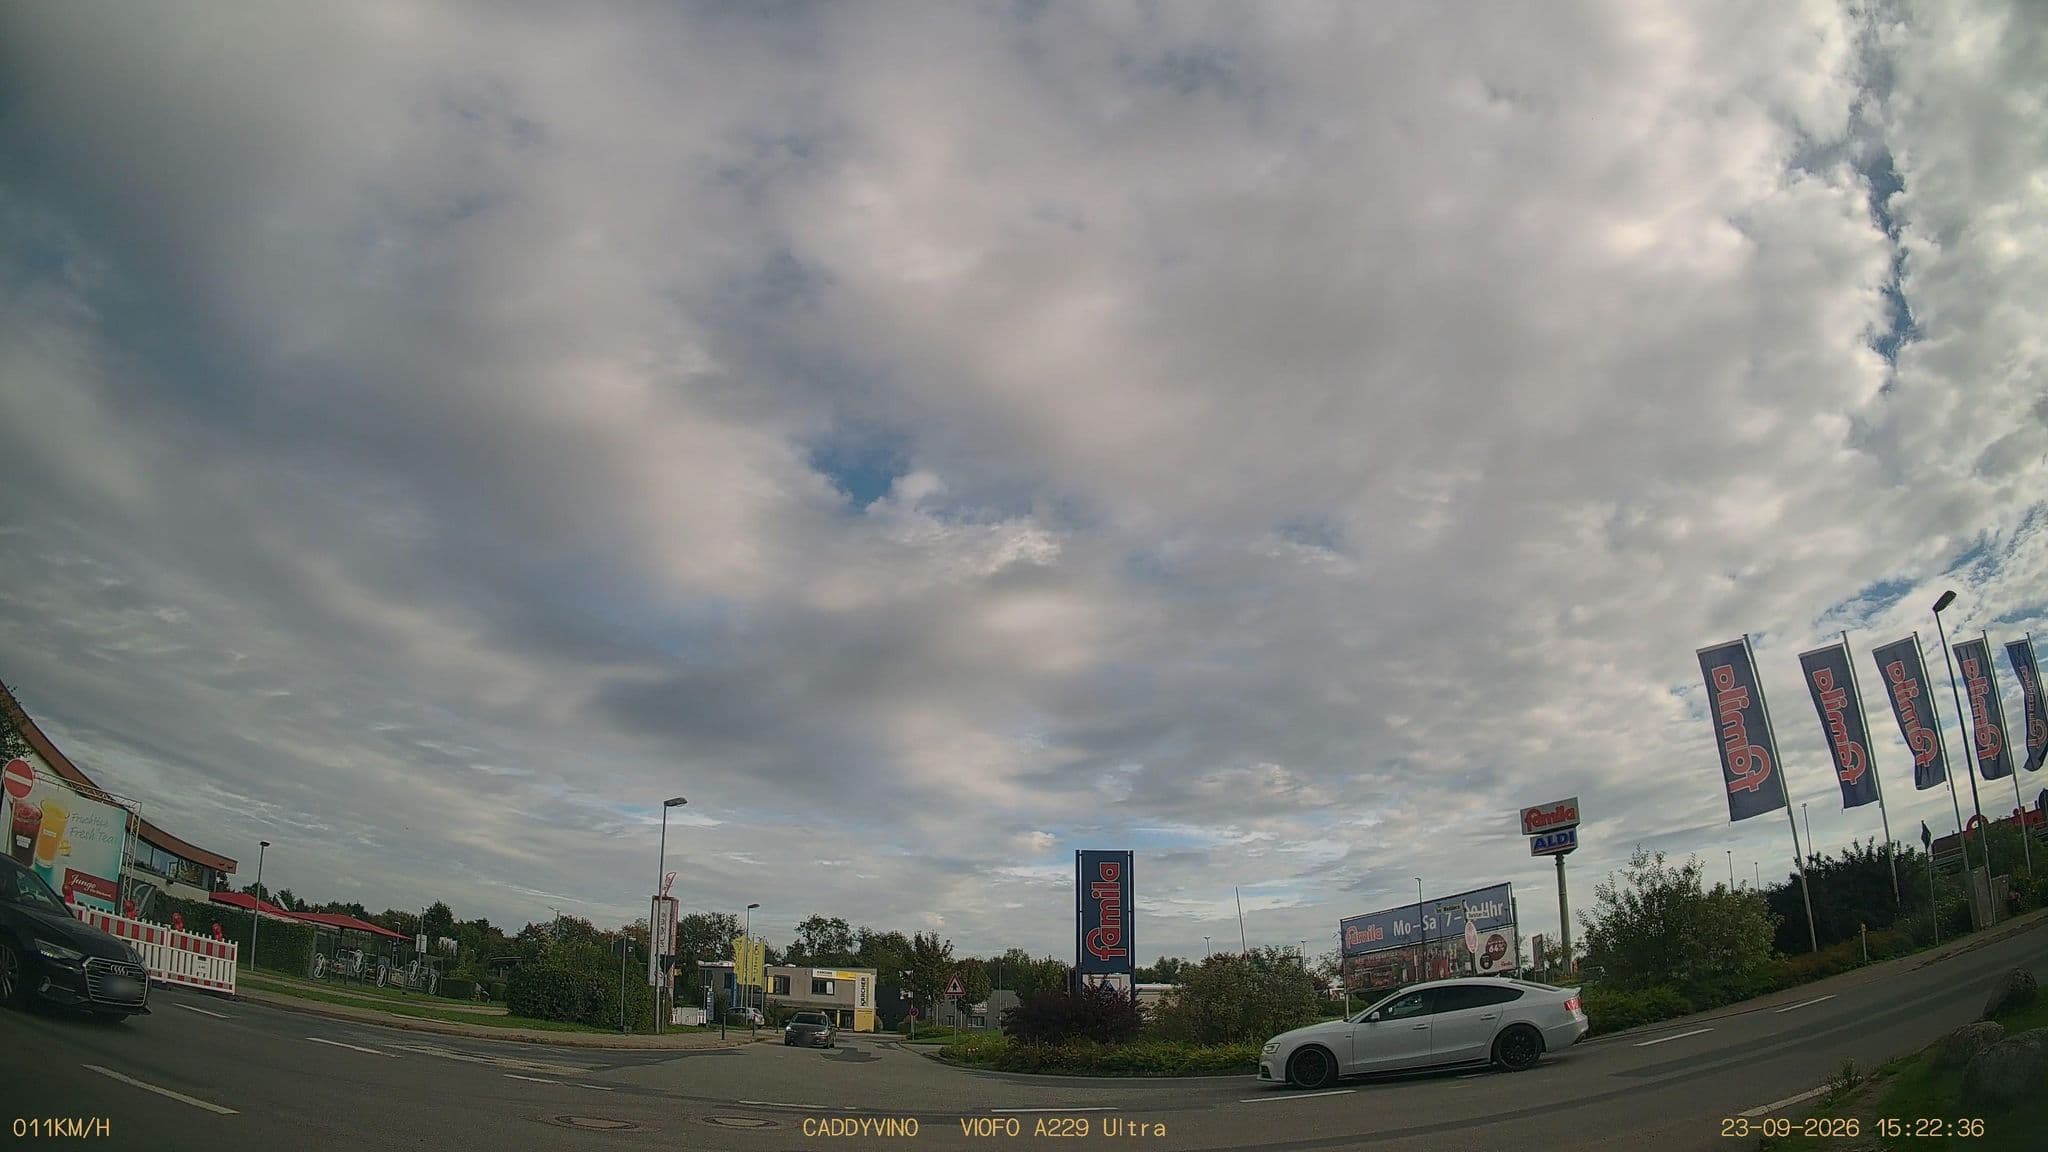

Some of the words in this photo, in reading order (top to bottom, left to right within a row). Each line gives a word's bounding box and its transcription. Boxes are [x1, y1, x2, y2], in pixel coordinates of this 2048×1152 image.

[1525, 805, 1576, 832] famila
[1534, 831, 1576, 850] ALDI
[1086, 862, 1127, 961] famila
[1345, 923, 1384, 950] famila
